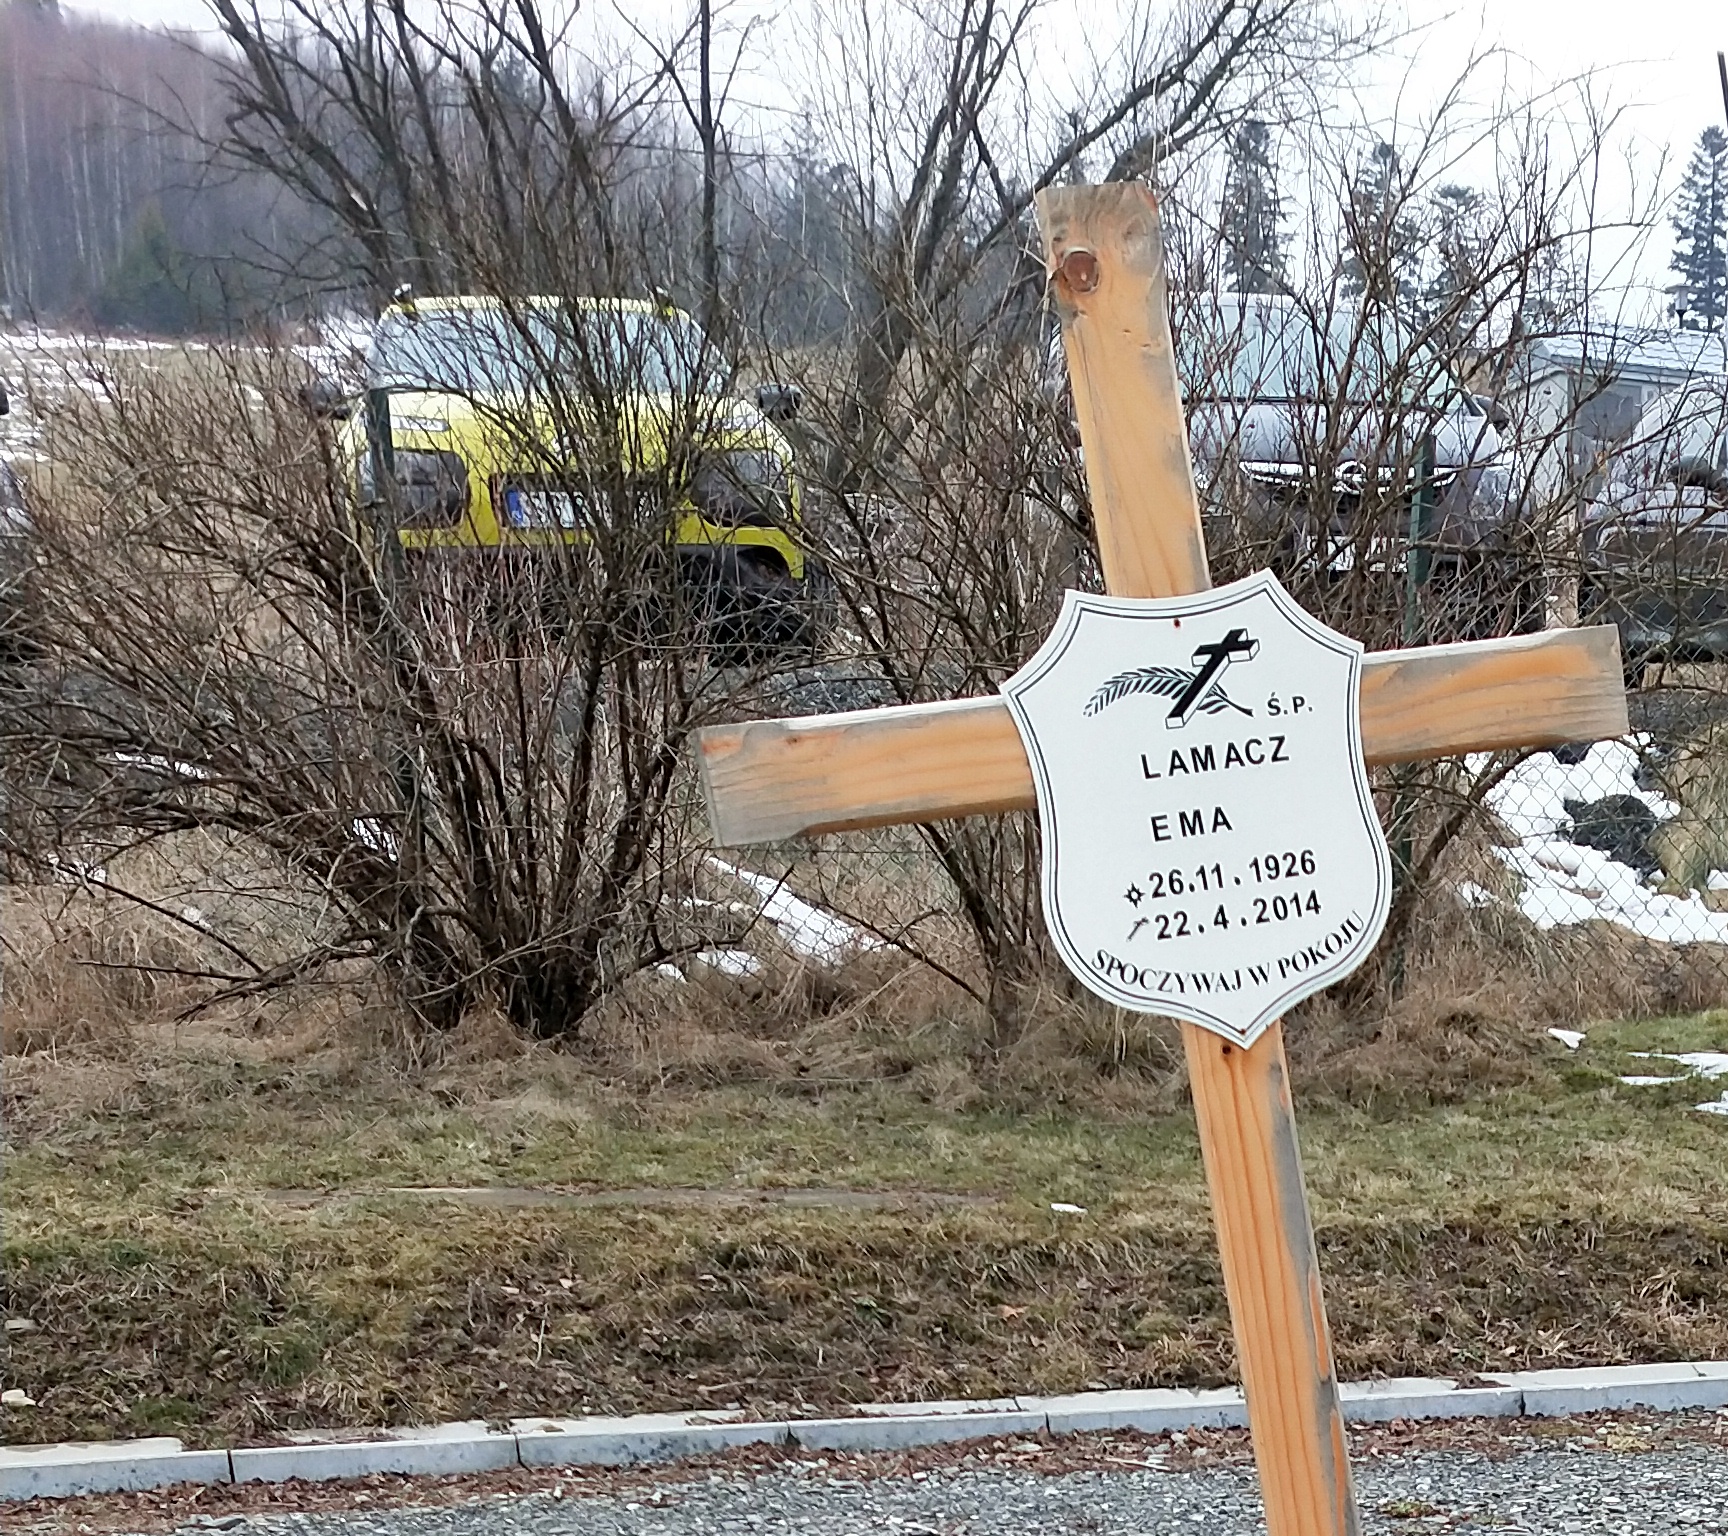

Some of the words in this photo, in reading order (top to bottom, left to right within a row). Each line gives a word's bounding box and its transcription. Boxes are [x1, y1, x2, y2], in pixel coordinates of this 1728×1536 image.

[1266, 691, 1313, 717] Ś.P.
[1140, 735, 1290, 780] LAMACZ
[1150, 806, 1233, 842] EMA
[1091, 949, 1243, 995] SPOCZYWAJ
[1249, 962, 1271, 987] W
[1277, 909, 1365, 980] POKOJU
